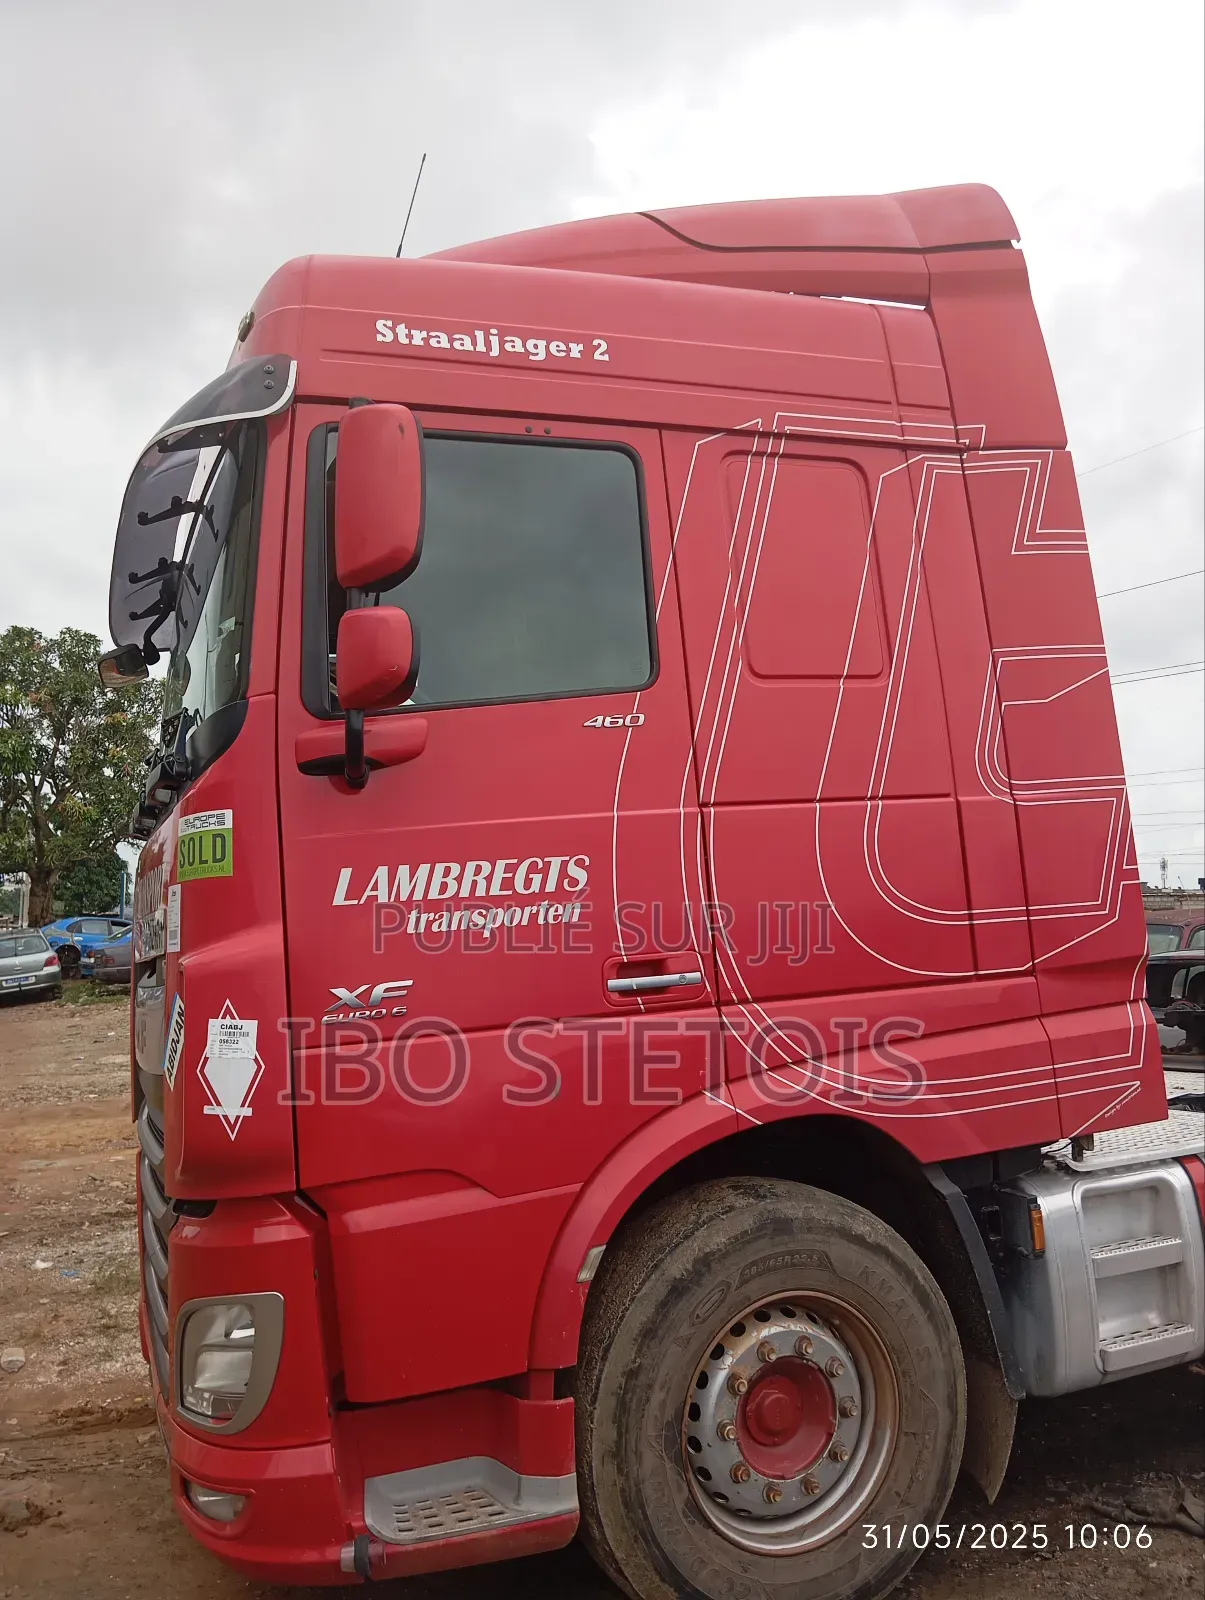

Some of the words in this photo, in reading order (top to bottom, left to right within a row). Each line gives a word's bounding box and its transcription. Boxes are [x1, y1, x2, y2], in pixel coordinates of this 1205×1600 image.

[375, 319, 584, 361] Straaljager
[592, 339, 610, 361] 2
[583, 713, 645, 728] 460
[185, 813, 226, 825] EUROPE
[186, 820, 226, 831] TRUCKS
[180, 833, 227, 869] SOLD
[332, 854, 590, 906] LAMBREGTS
[406, 899, 582, 938] transporten
[324, 980, 414, 1012] XF
[220, 1023, 244, 1031] CIABJ
[321, 1009, 387, 1025] EURO
[391, 1006, 407, 1017] 6
[166, 1004, 185, 1083] ABIDJAN
